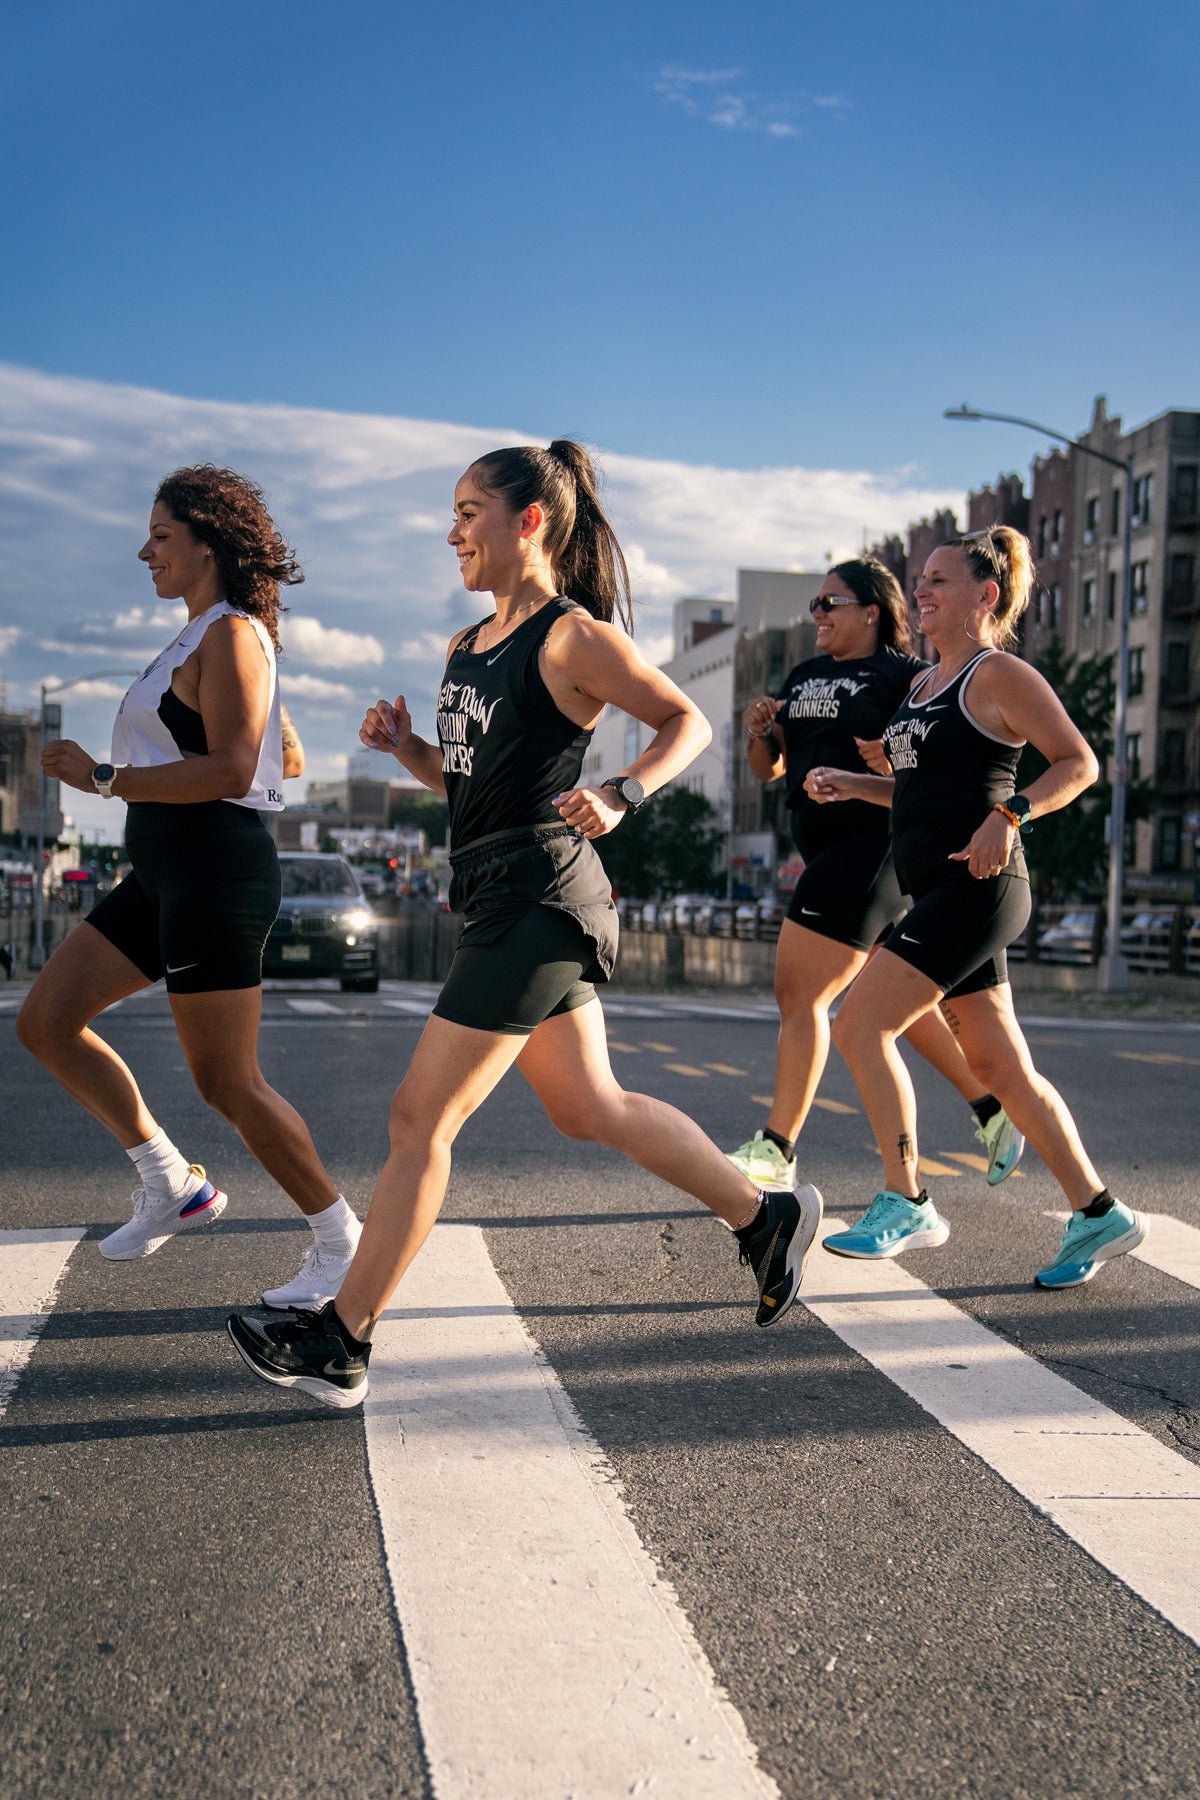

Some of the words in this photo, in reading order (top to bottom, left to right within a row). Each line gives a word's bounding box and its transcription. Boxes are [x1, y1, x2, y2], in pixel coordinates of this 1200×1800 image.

[457, 685, 503, 734] DOWN
[789, 700, 840, 719] RUNNERS
[889, 733, 913, 753] BRONX
